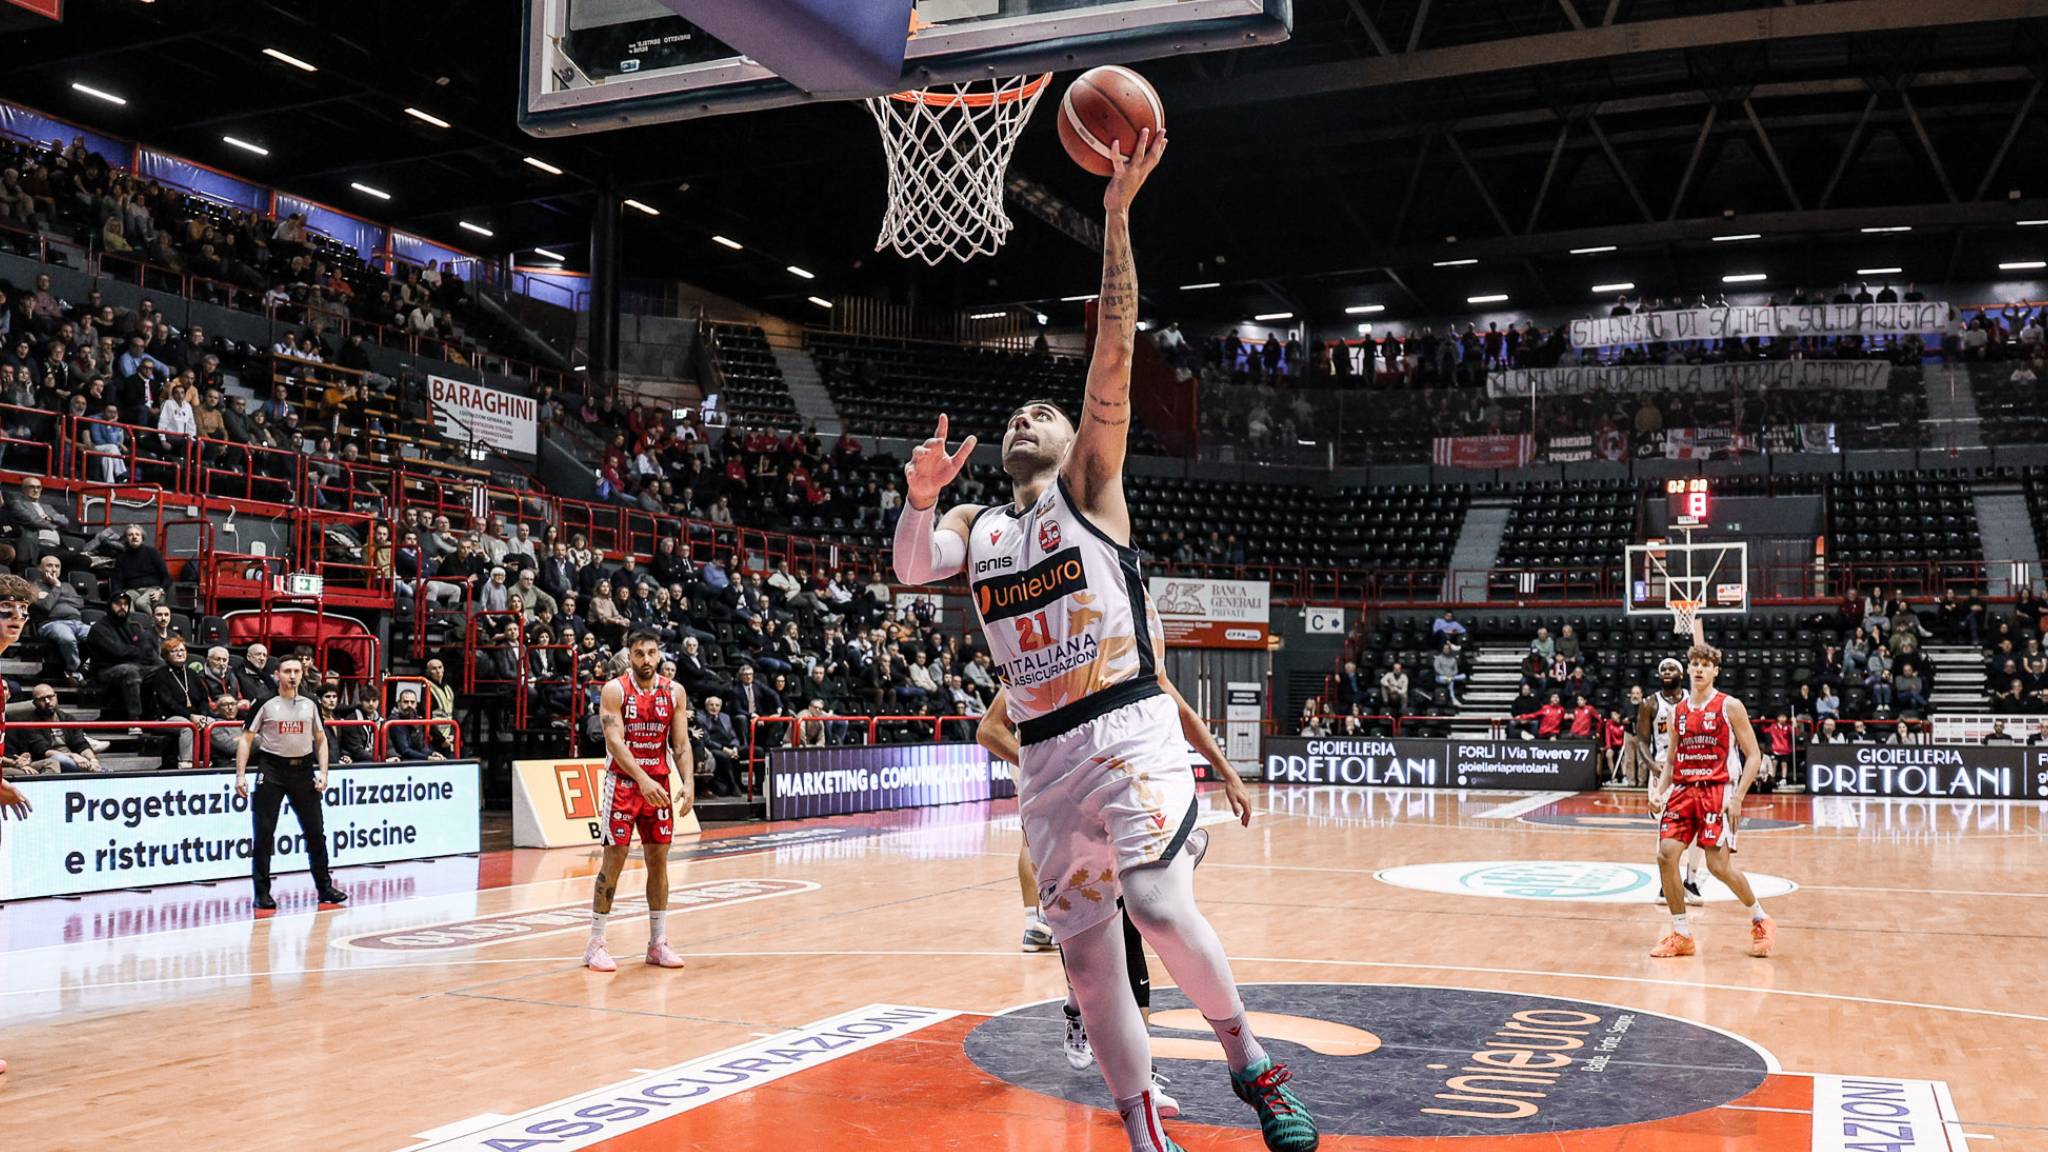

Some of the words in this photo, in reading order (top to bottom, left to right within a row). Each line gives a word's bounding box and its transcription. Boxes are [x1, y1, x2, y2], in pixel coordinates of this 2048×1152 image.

[1676, 312, 1698, 338] DI
[433, 379, 533, 422] BARAGHINI
[1690, 492, 1706, 516] 8
[975, 556, 1013, 575] IGNIS
[995, 560, 1082, 607] unieuro
[1211, 584, 1248, 597] BANCA
[1210, 597, 1263, 610] GENERALI
[1015, 611, 1051, 653] 21
[1312, 615, 1325, 631] C
[1009, 633, 1097, 676] ITALIANA
[1014, 647, 1098, 688] ASSICURAZIONI
[625, 705, 638, 719] 15
[1307, 741, 1396, 756] GIOIELLERIA
[1508, 747, 1527, 760] Via
[1529, 747, 1571, 760] Tevere
[1573, 749, 1589, 761] 77
[1856, 748, 1964, 765] GIOIELLERIA
[776, 772, 868, 798] MARKETING
[870, 775, 878, 790] e
[881, 764, 987, 788] COMUNICAZIONE
[1268, 756, 1436, 785] PRETOLANI
[1458, 761, 1559, 776] gioielleriapretolani.it
[1811, 764, 2011, 796] PRETOLANI
[65, 850, 85, 874] e
[334, 819, 417, 857] piscine
[1421, 1008, 1602, 1119] unieuro
